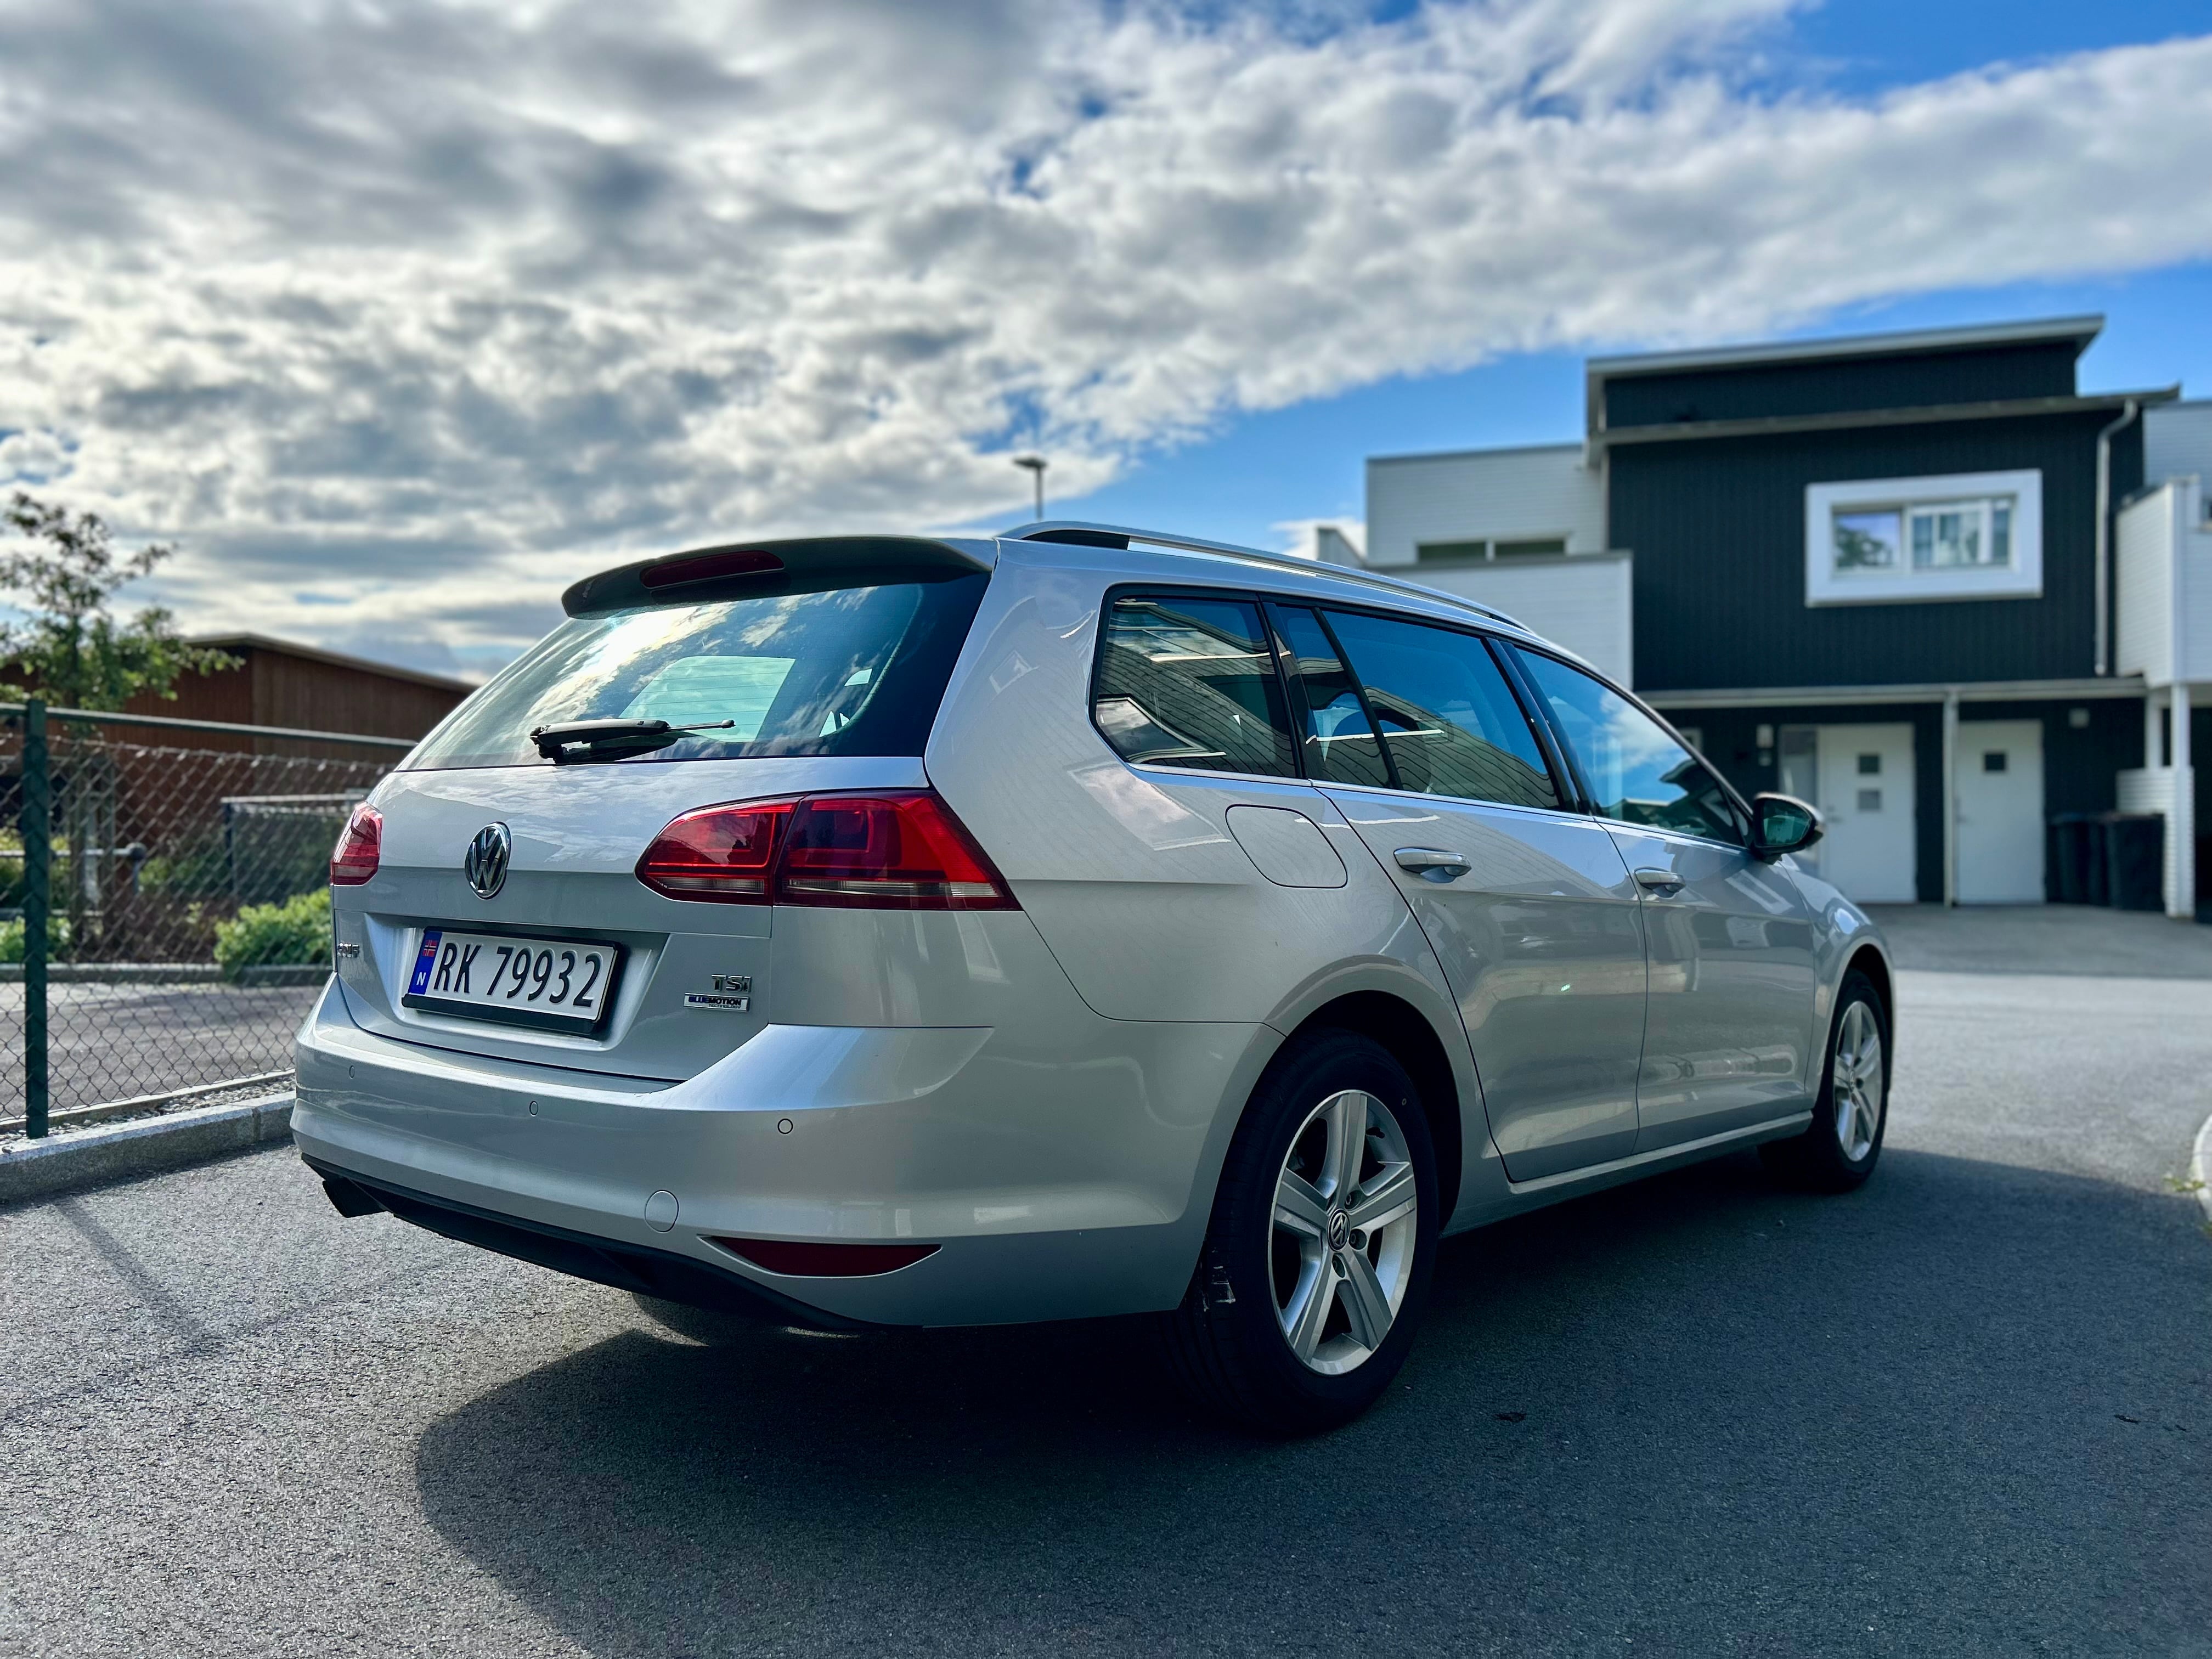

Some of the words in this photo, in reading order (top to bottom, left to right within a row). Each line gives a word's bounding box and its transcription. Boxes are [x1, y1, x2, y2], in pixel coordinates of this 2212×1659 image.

[416, 972, 427, 986] N
[433, 943, 482, 994] RK
[487, 945, 603, 1008] 79932
[712, 974, 751, 992] TSI
